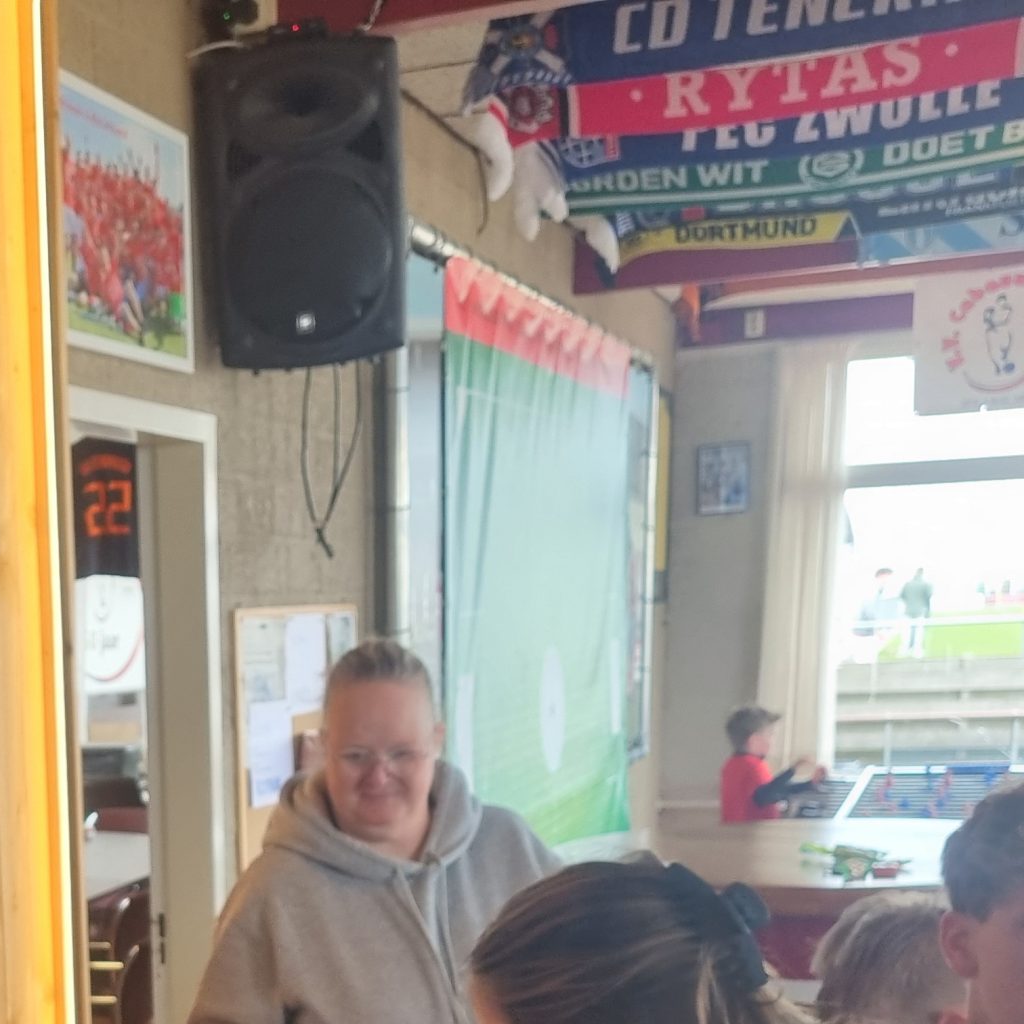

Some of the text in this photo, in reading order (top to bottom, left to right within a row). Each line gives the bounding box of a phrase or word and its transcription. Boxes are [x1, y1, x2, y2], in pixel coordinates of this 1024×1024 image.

[612, 2, 689, 55] CD
[662, 37, 923, 119] RYTAS
[793, 80, 1002, 145] ZWOLLE
[696, 160, 770, 186] WIT
[882, 127, 993, 167] DOET
[675, 215, 818, 245] DORTMUND
[82, 479, 133, 537] 22
